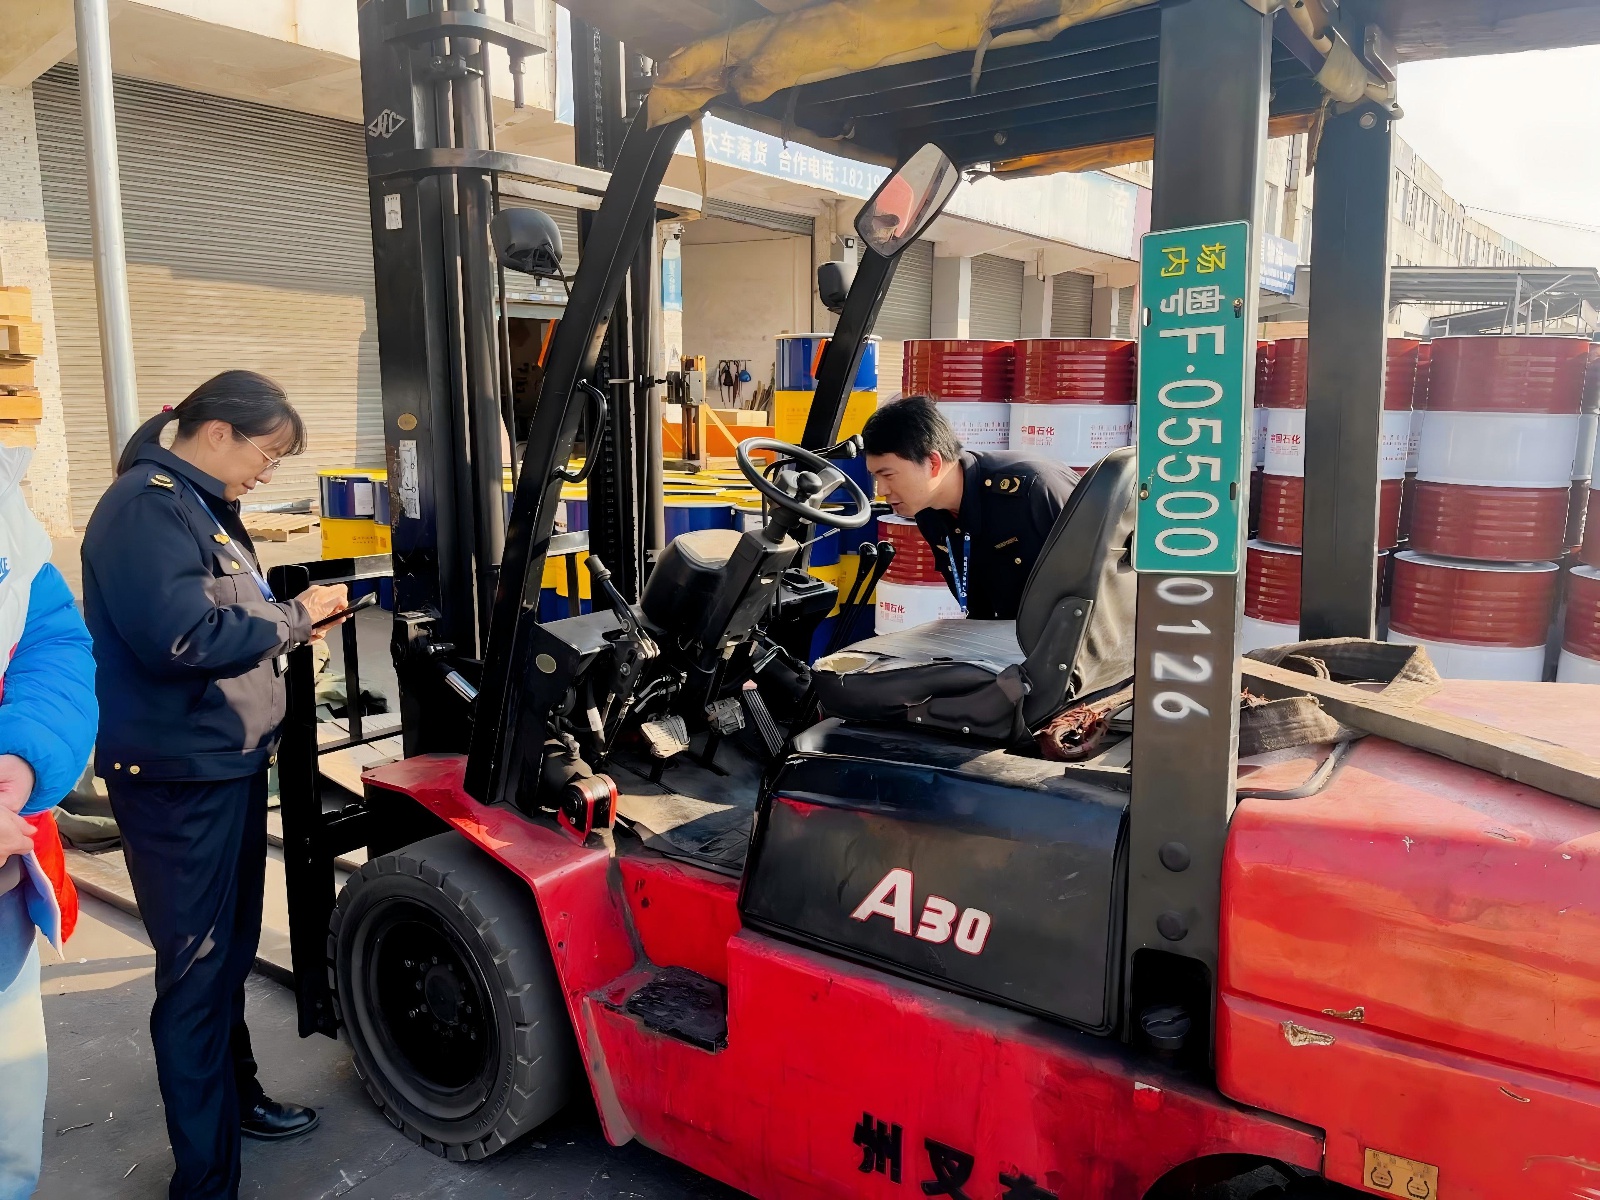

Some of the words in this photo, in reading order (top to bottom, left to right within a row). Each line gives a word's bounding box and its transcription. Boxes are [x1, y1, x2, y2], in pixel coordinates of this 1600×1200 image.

[1160, 243, 1226, 277] 场内
[1153, 577, 1214, 717] 0126
[849, 867, 992, 956] A30
